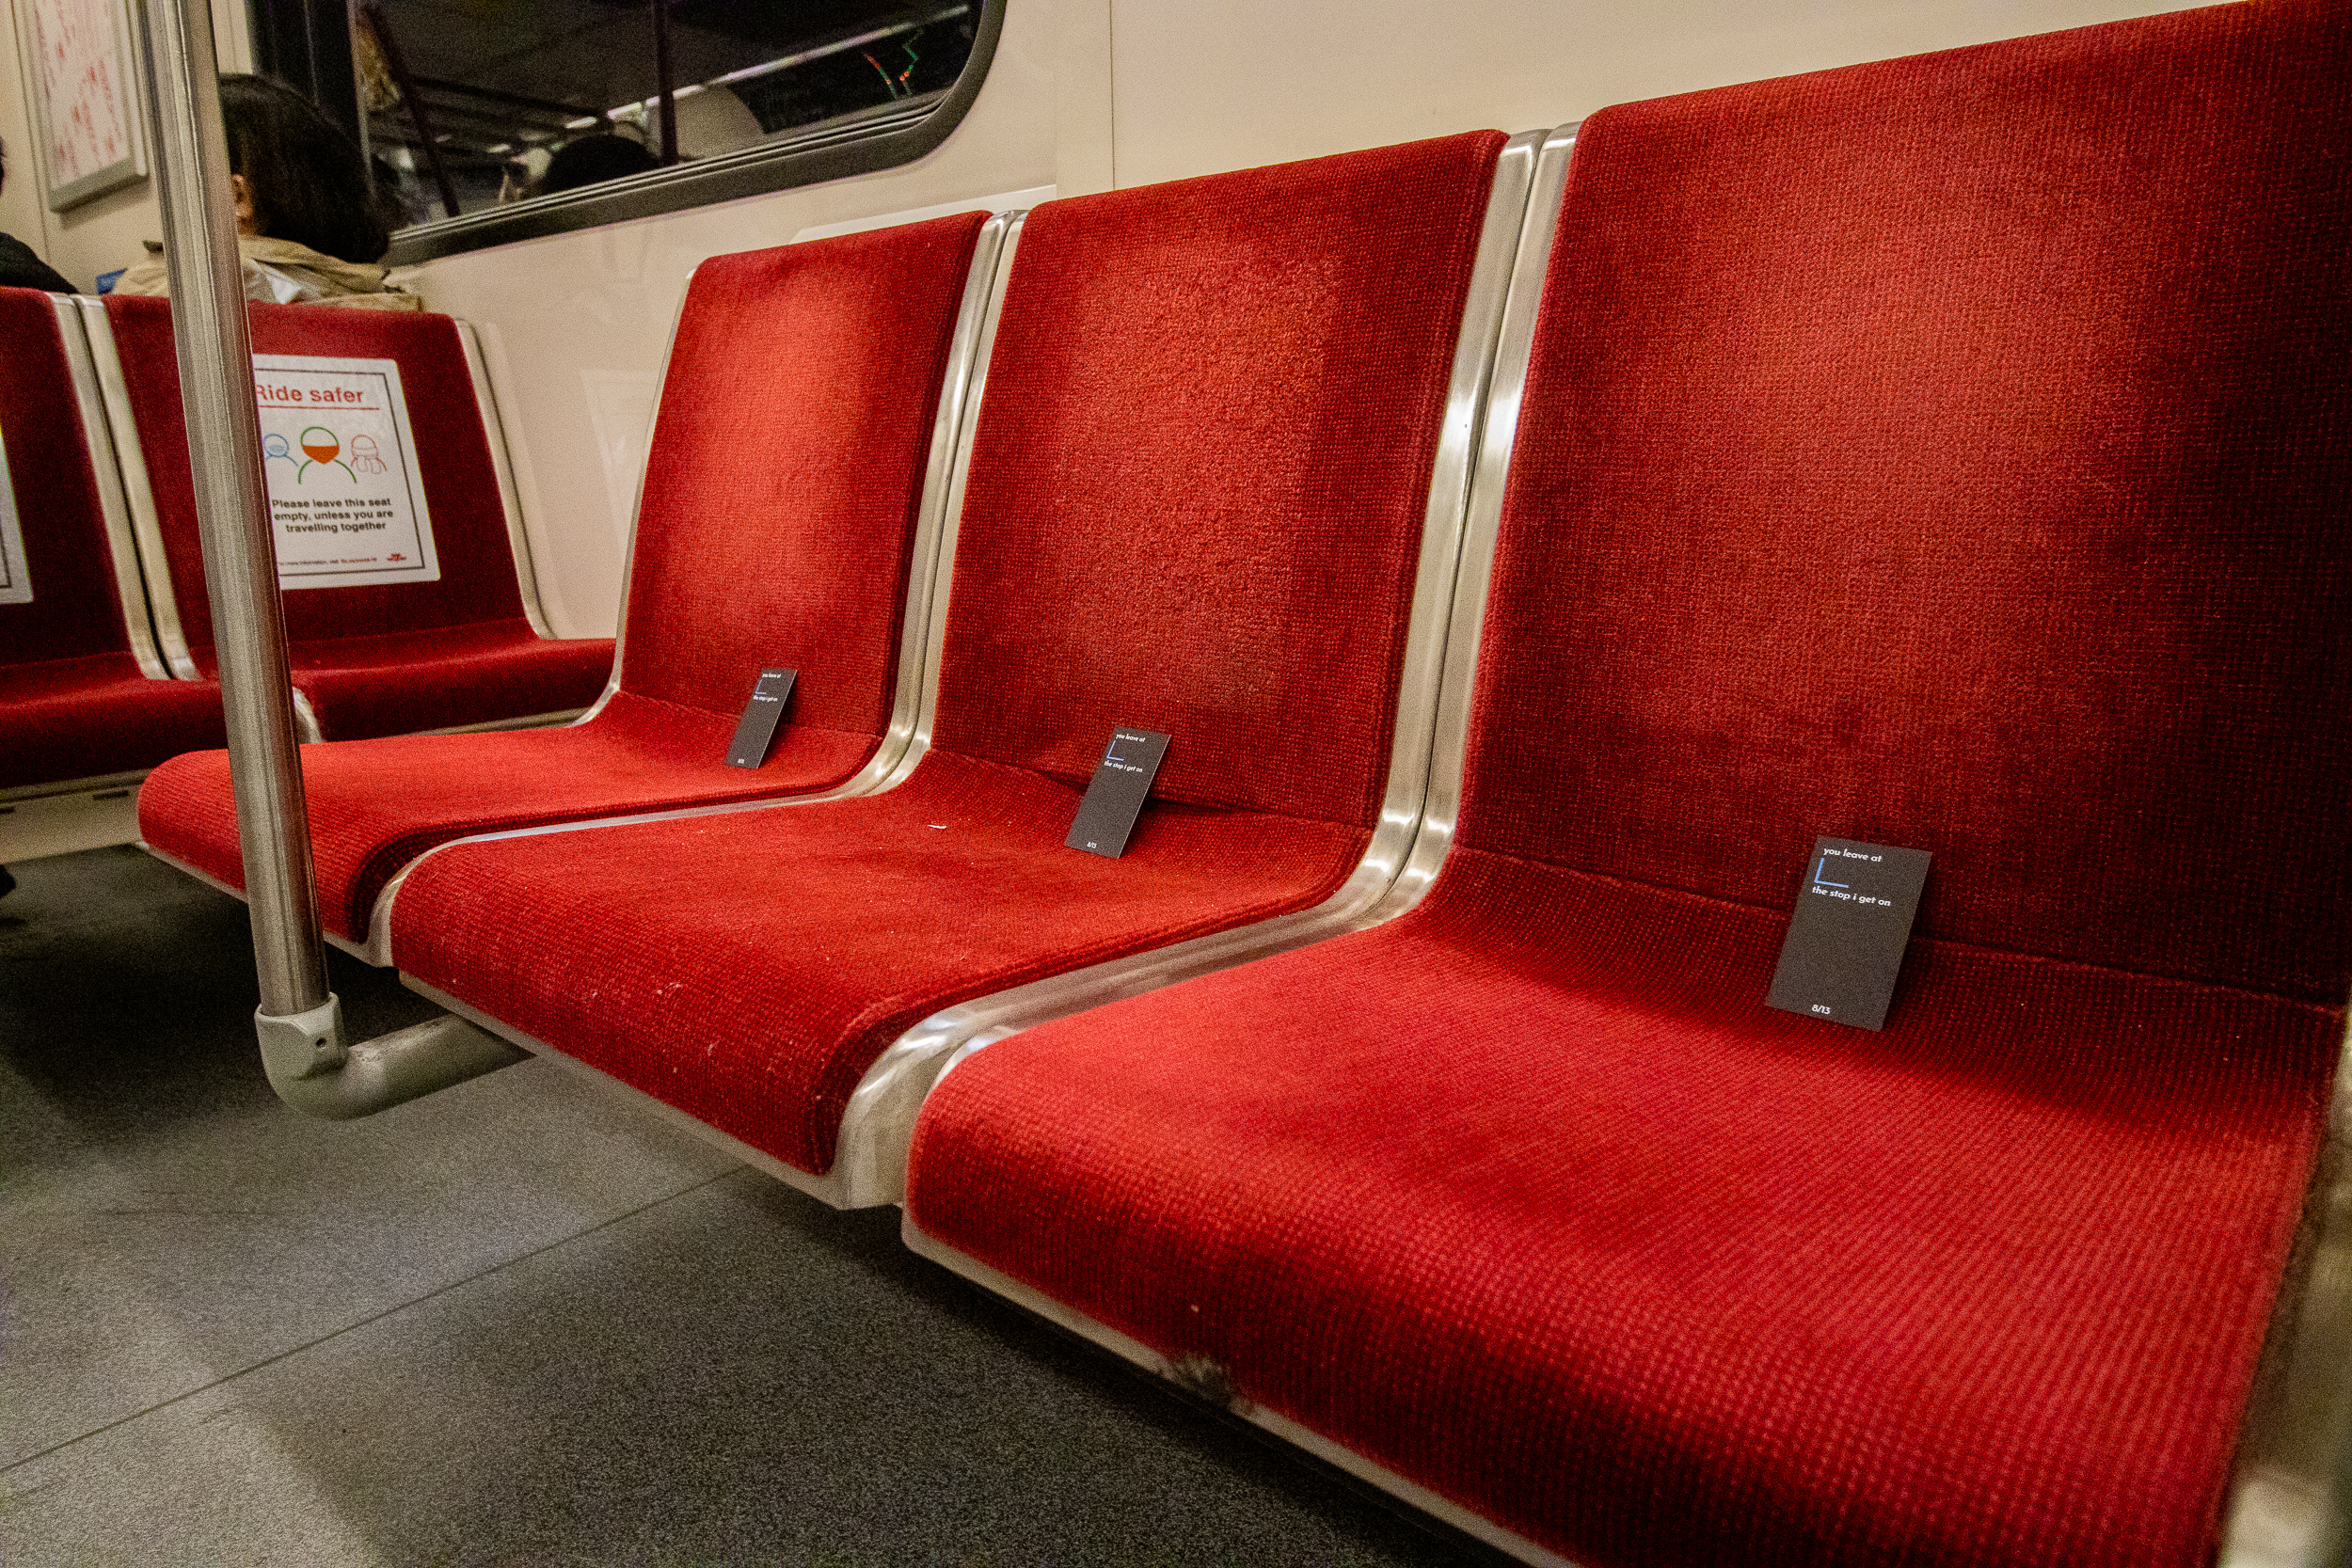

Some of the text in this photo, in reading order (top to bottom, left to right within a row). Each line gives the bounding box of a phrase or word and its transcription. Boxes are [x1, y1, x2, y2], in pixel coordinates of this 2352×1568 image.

[256, 384, 363, 403] Ride safer
[272, 498, 391, 509] Please leave this seat
[274, 510, 393, 522] empty, unless you are
[285, 521, 387, 534] travelling together
[1823, 847, 1841, 856] you
[1842, 848, 1869, 861] leave
[1812, 885, 1828, 895] the
[1829, 890, 1851, 900] stop
[1852, 893, 1858, 901] i
[1858, 895, 1876, 904] get
[1811, 1004, 1831, 1015] 8/13
